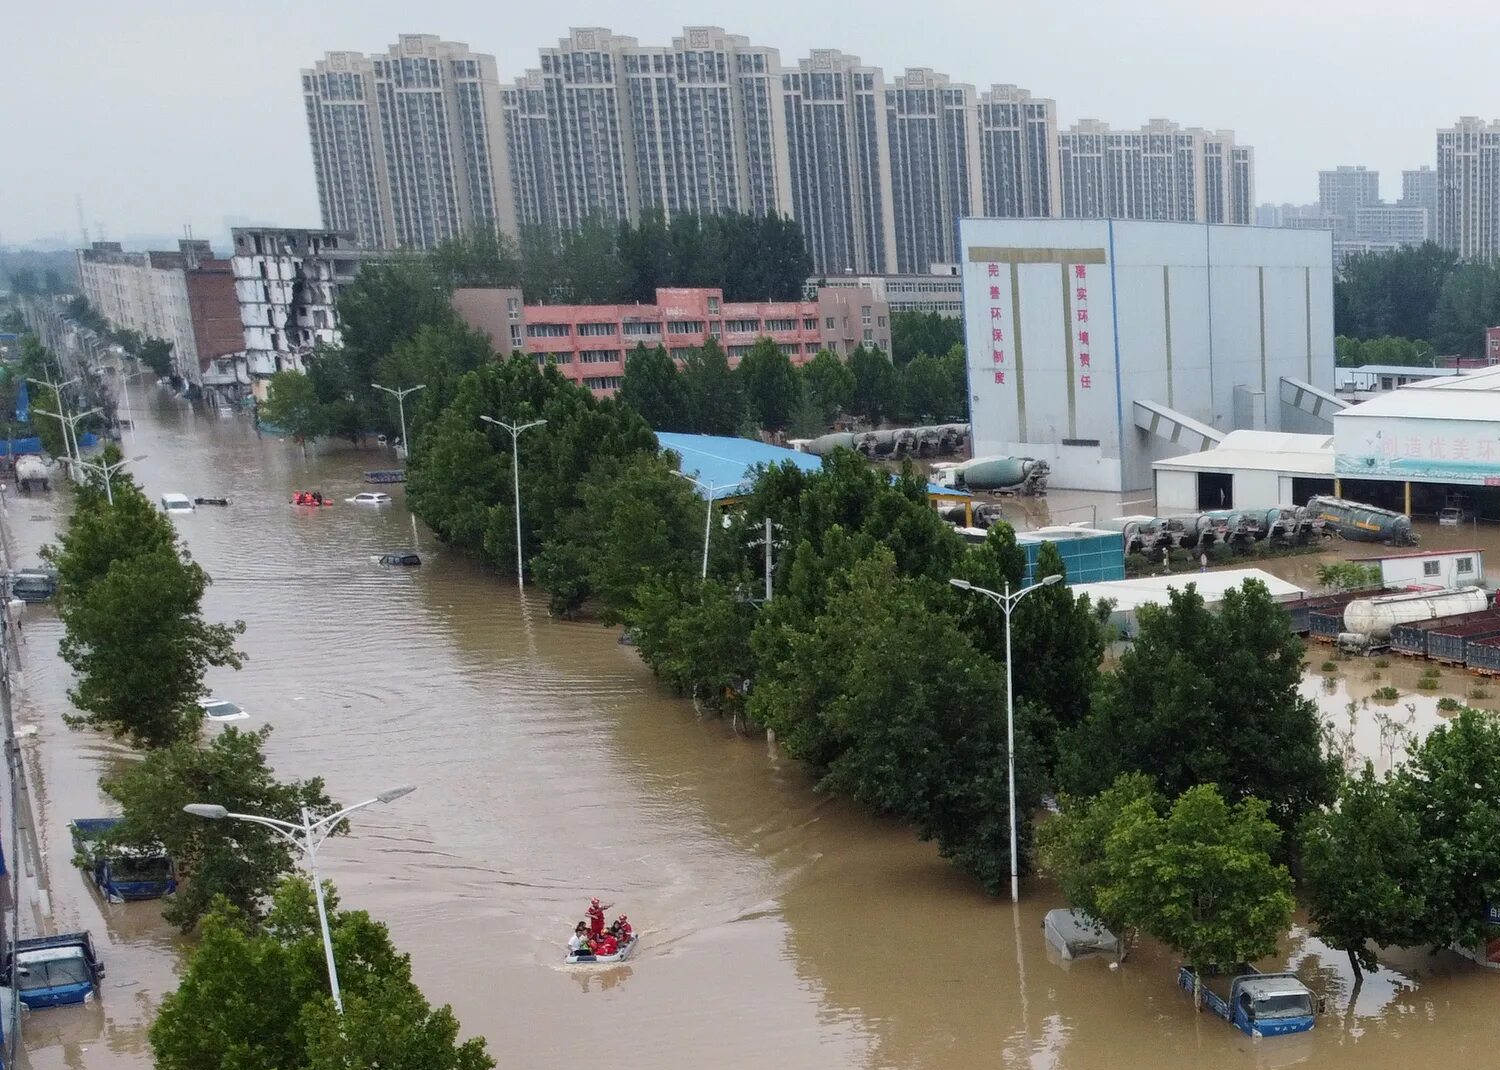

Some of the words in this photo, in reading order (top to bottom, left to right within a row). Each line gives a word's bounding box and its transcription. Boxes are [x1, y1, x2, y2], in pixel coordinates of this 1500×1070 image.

[988, 262, 1005, 384] 完善环保制度
[1075, 265, 1091, 389] 落实环境责任
